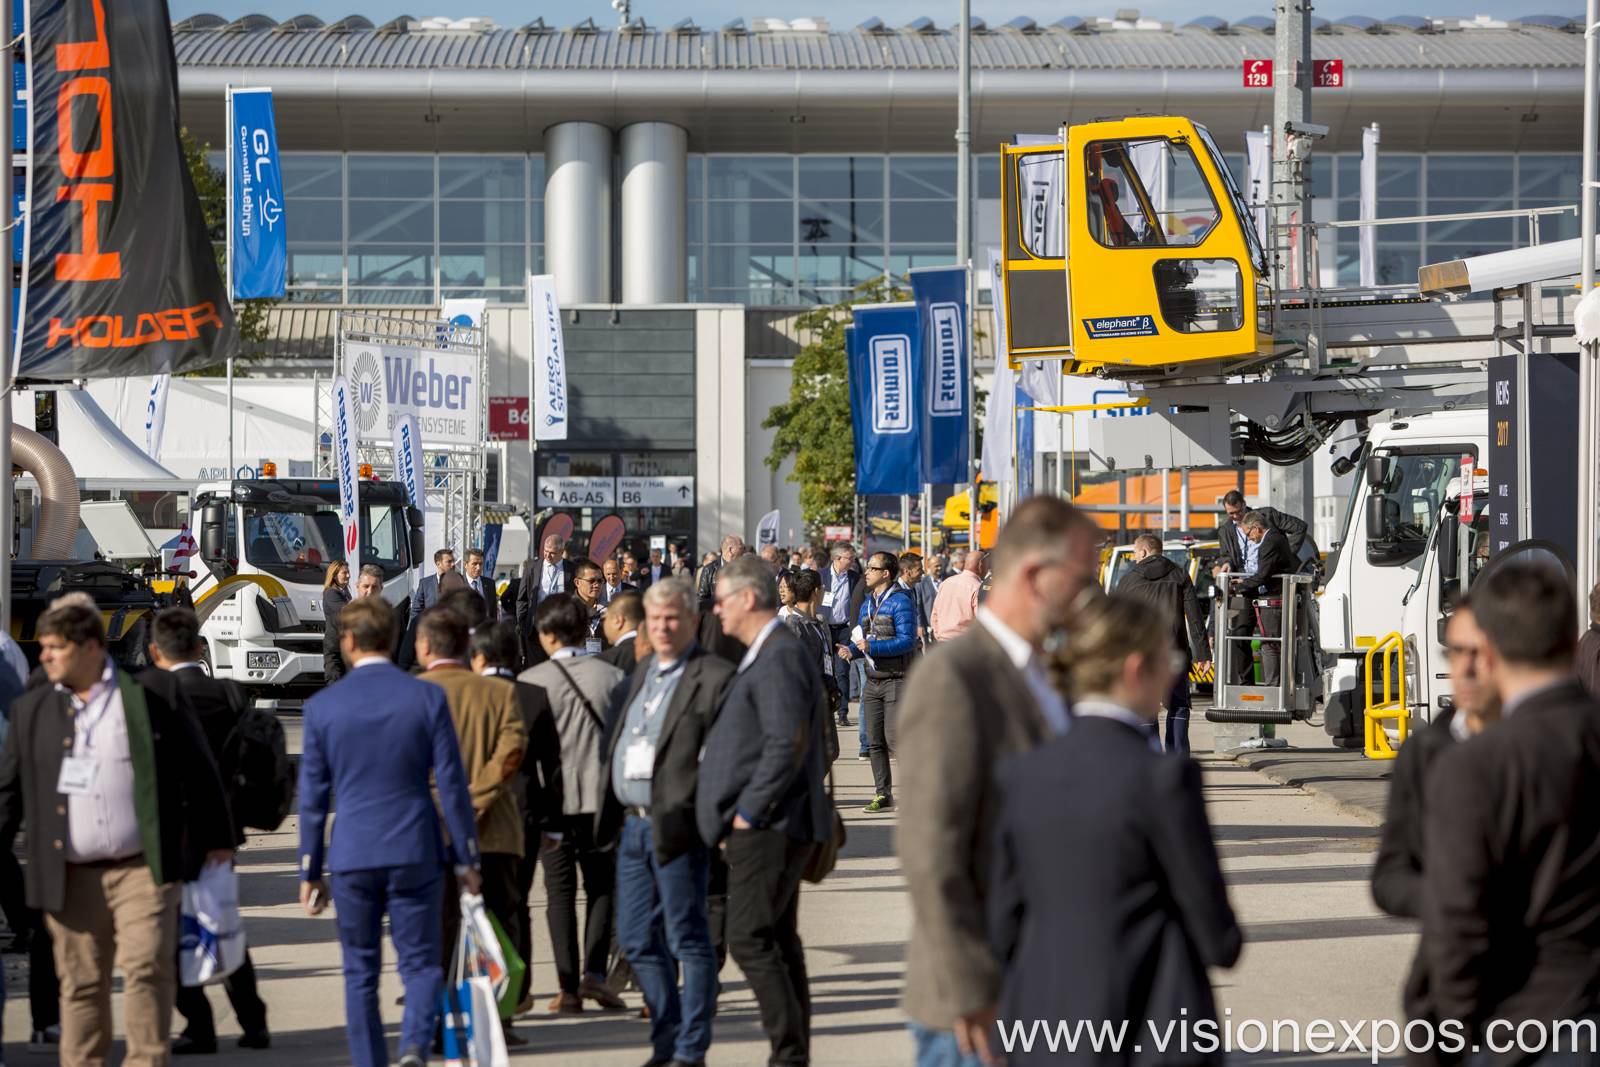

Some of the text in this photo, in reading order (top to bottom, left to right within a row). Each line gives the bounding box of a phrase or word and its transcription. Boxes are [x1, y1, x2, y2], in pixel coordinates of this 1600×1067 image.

[1247, 73, 1268, 86] 129
[1320, 73, 1340, 86] 129
[253, 128, 271, 183] GL
[242, 187, 253, 237] Lebrun
[47, 302, 224, 348] HOLDER
[384, 356, 472, 410] Weber
[508, 408, 530, 424] B6
[558, 491, 604, 503] A6-A5
[622, 491, 642, 503] B6
